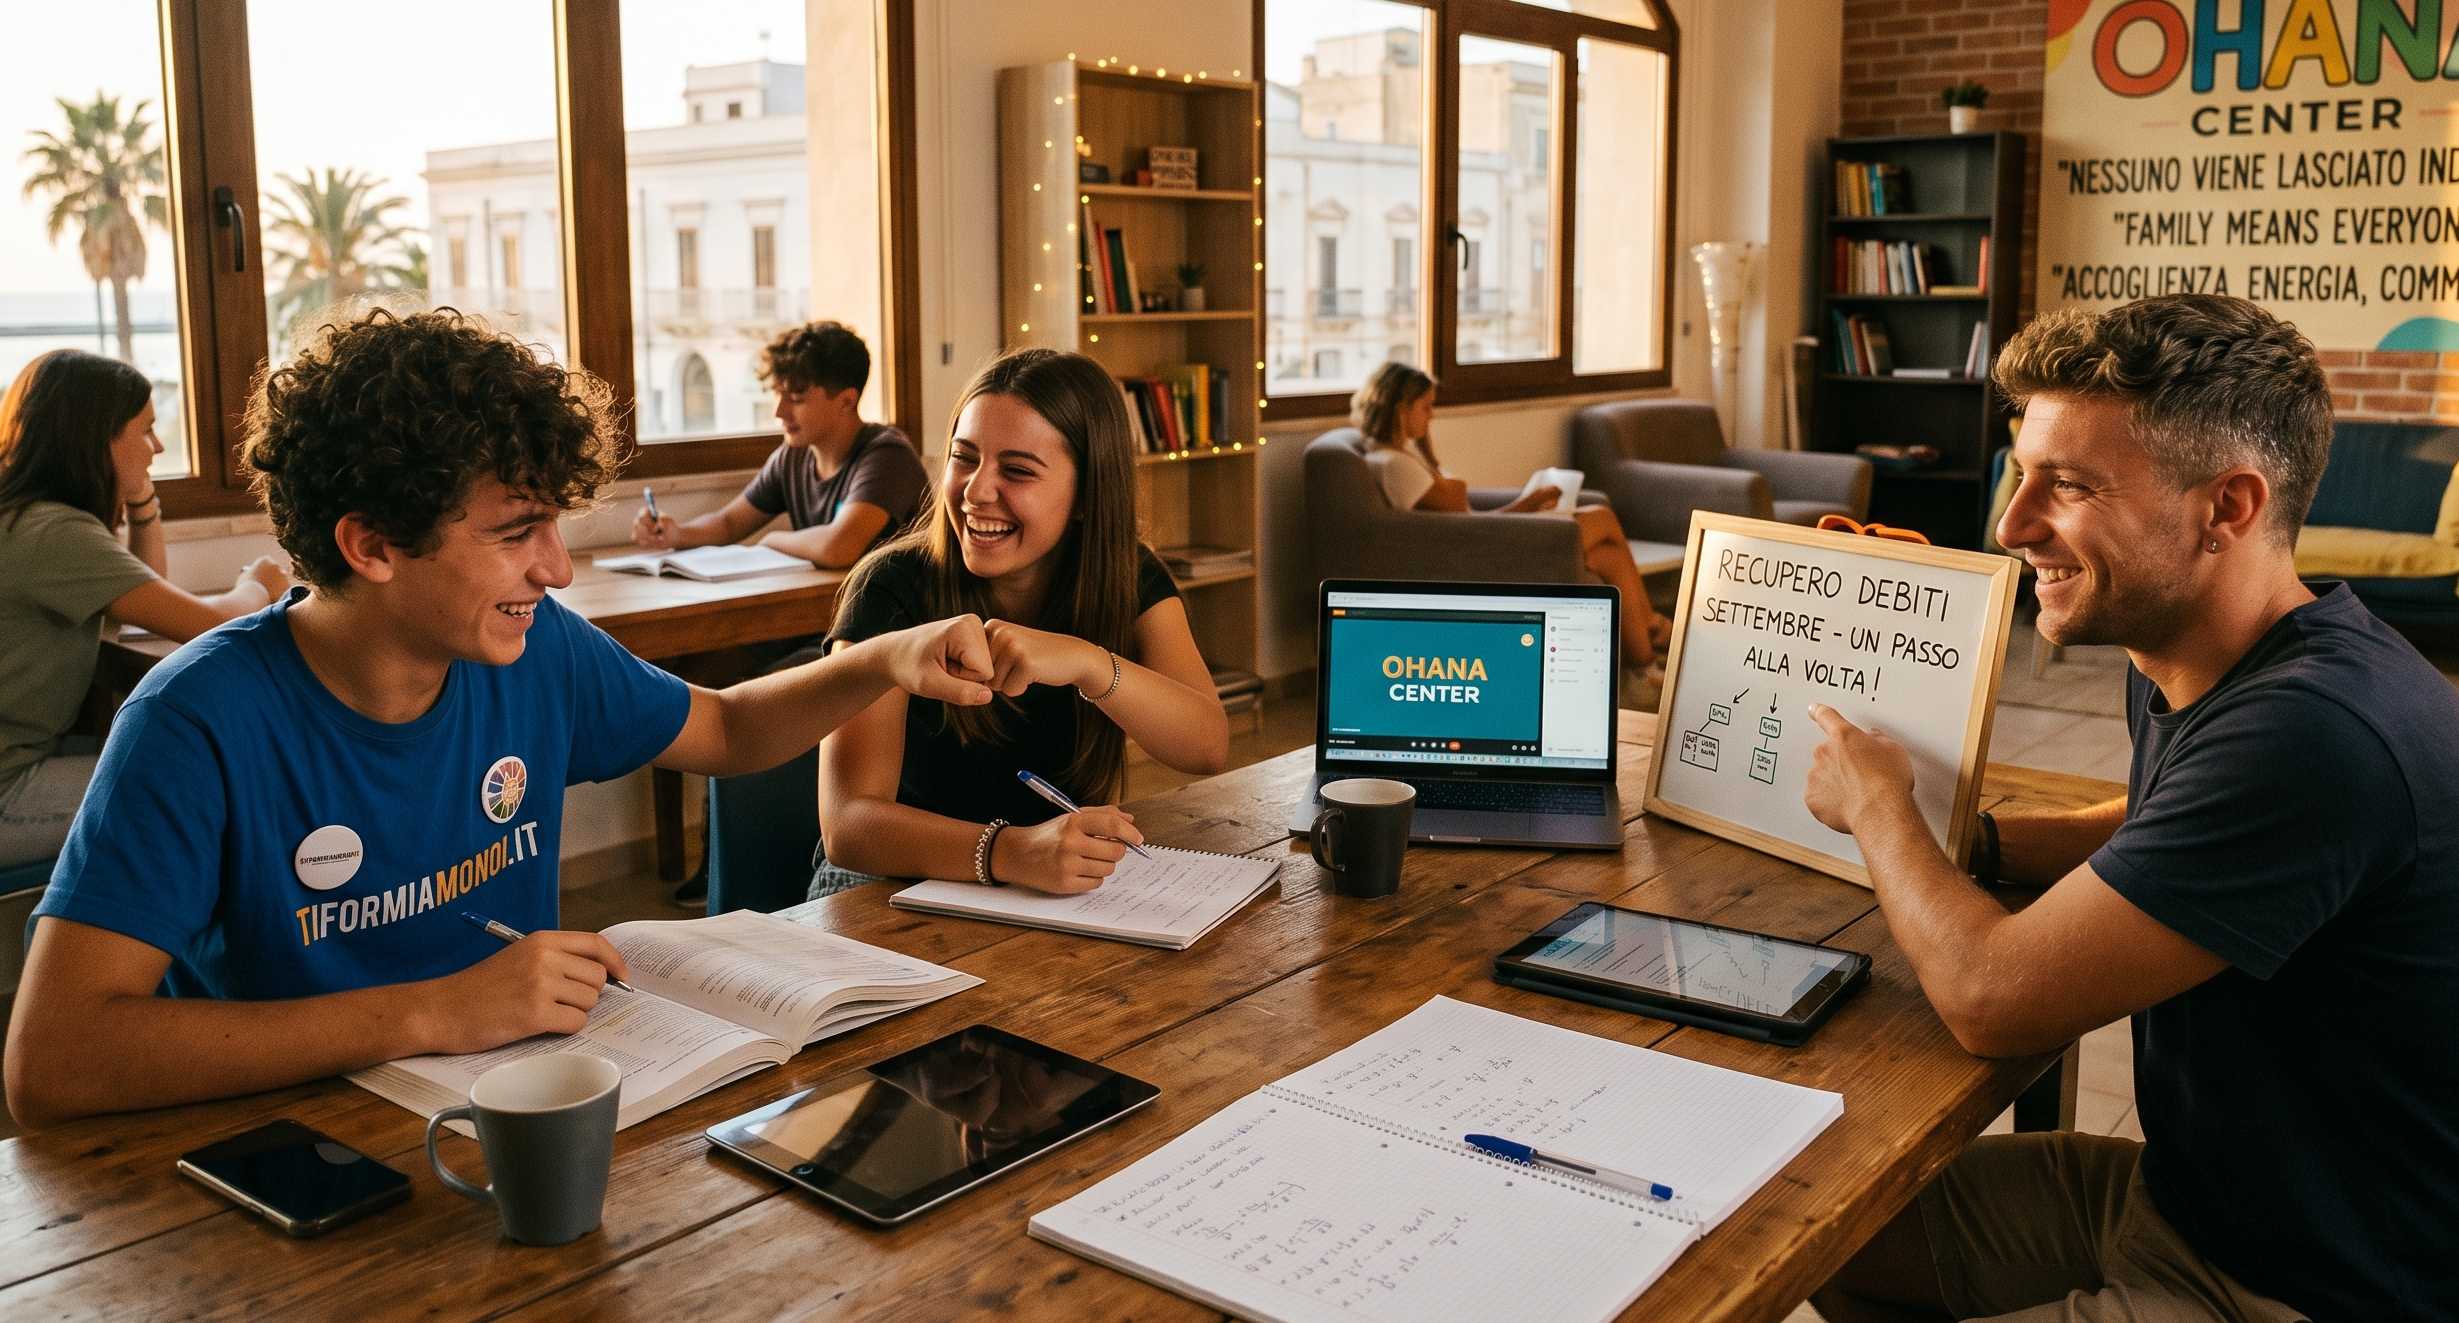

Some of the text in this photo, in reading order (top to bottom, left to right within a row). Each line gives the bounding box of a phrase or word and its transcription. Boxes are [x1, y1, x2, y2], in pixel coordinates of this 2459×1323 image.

[2091, 0, 2459, 98] OHAN
[2191, 98, 2403, 136] CENTER
[2058, 157, 2182, 195] "NESSUNO
[2193, 154, 2267, 190] VIENE
[2277, 149, 2406, 189] LASCIATO
[2114, 207, 2459, 246] "FAMILY MEANS EVERYON
[2248, 265, 2367, 306] ENERGIA,
[2380, 265, 2459, 301] COMM
[1718, 548, 1950, 622] RECUPERO DEBITI
[1702, 597, 1825, 642] SETTEMBRE
[1850, 626, 1880, 653] UN
[1891, 632, 1960, 670] PASSO
[1382, 655, 1488, 681] OHANA
[1743, 646, 1790, 677] ALLA
[1389, 683, 1480, 703] CENTER
